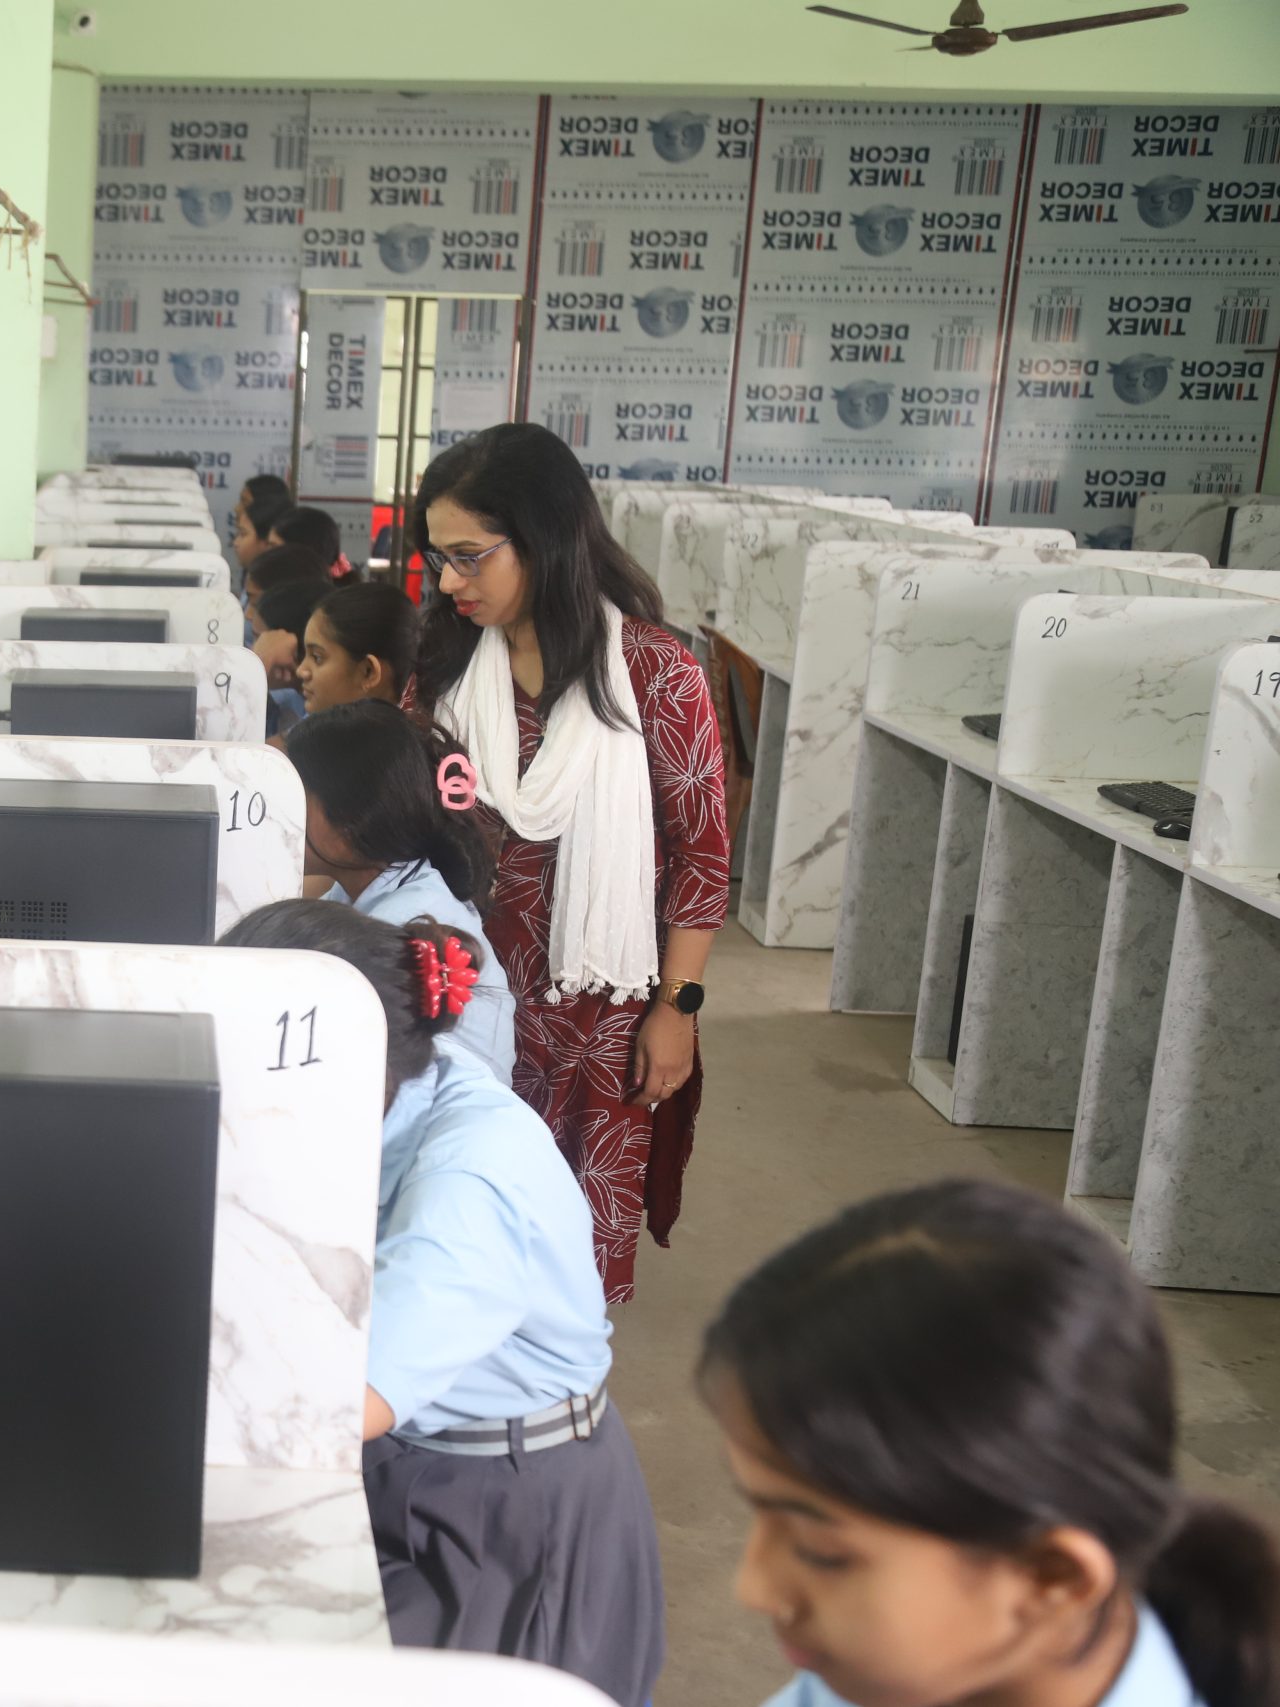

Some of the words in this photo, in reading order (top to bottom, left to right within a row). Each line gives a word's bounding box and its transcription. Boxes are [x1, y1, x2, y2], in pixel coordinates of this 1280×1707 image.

[170, 121, 248, 139] DECOR
[559, 117, 638, 134] DECOR
[1134, 115, 1219, 133] DECOR
[171, 143, 246, 161] TIMEX
[559, 138, 635, 157] TIMEX
[849, 146, 930, 164] DECOR
[1131, 137, 1214, 157] TIMEX
[369, 166, 447, 183] DECOR
[848, 168, 926, 187] TIMEX
[370, 188, 444, 206] TIMEX
[1041, 182, 1124, 199] DECOR
[1207, 182, 1280, 200] ECOR
[763, 210, 841, 228] DECOR
[921, 212, 1001, 230] DECOR
[1039, 204, 1119, 223] TIMEX
[442, 231, 519, 248] DECOR
[630, 230, 708, 247] DECOR
[762, 232, 838, 250] TIMEX
[920, 234, 997, 253] TIMEX
[442, 252, 516, 271] TIMEX
[629, 252, 704, 270] TIMEX
[163, 288, 239, 306] DECOR
[546, 292, 623, 310] DECOR
[1108, 296, 1192, 313] DECOR
[163, 310, 237, 328] TIMEX
[546, 314, 620, 332] TIMEX
[1106, 317, 1186, 336] TIMEX
[831, 323, 909, 340] DECOR
[830, 345, 906, 363] TIMEX
[325, 333, 344, 411] DECOR
[346, 335, 366, 410] TIMEX
[1018, 359, 1099, 376] DECOR
[1180, 361, 1265, 378] DECOR
[746, 385, 823, 402] DECOR
[901, 387, 980, 404] DECOR
[1017, 379, 1095, 398] TIMEX
[1178, 382, 1259, 401] TIMEX
[616, 403, 692, 420] DECOR
[745, 405, 820, 424] TIMEX
[900, 408, 976, 427] TIMEX
[615, 424, 689, 442] TIMEX
[1084, 470, 1166, 487] DECOR
[901, 581, 920, 600] 21
[207, 619, 219, 644] 8
[1041, 616, 1067, 638] 20
[214, 672, 232, 703] 9
[1252, 669, 1280, 698] 19
[226, 790, 266, 832] 10
[266, 1006, 323, 1072] 11
